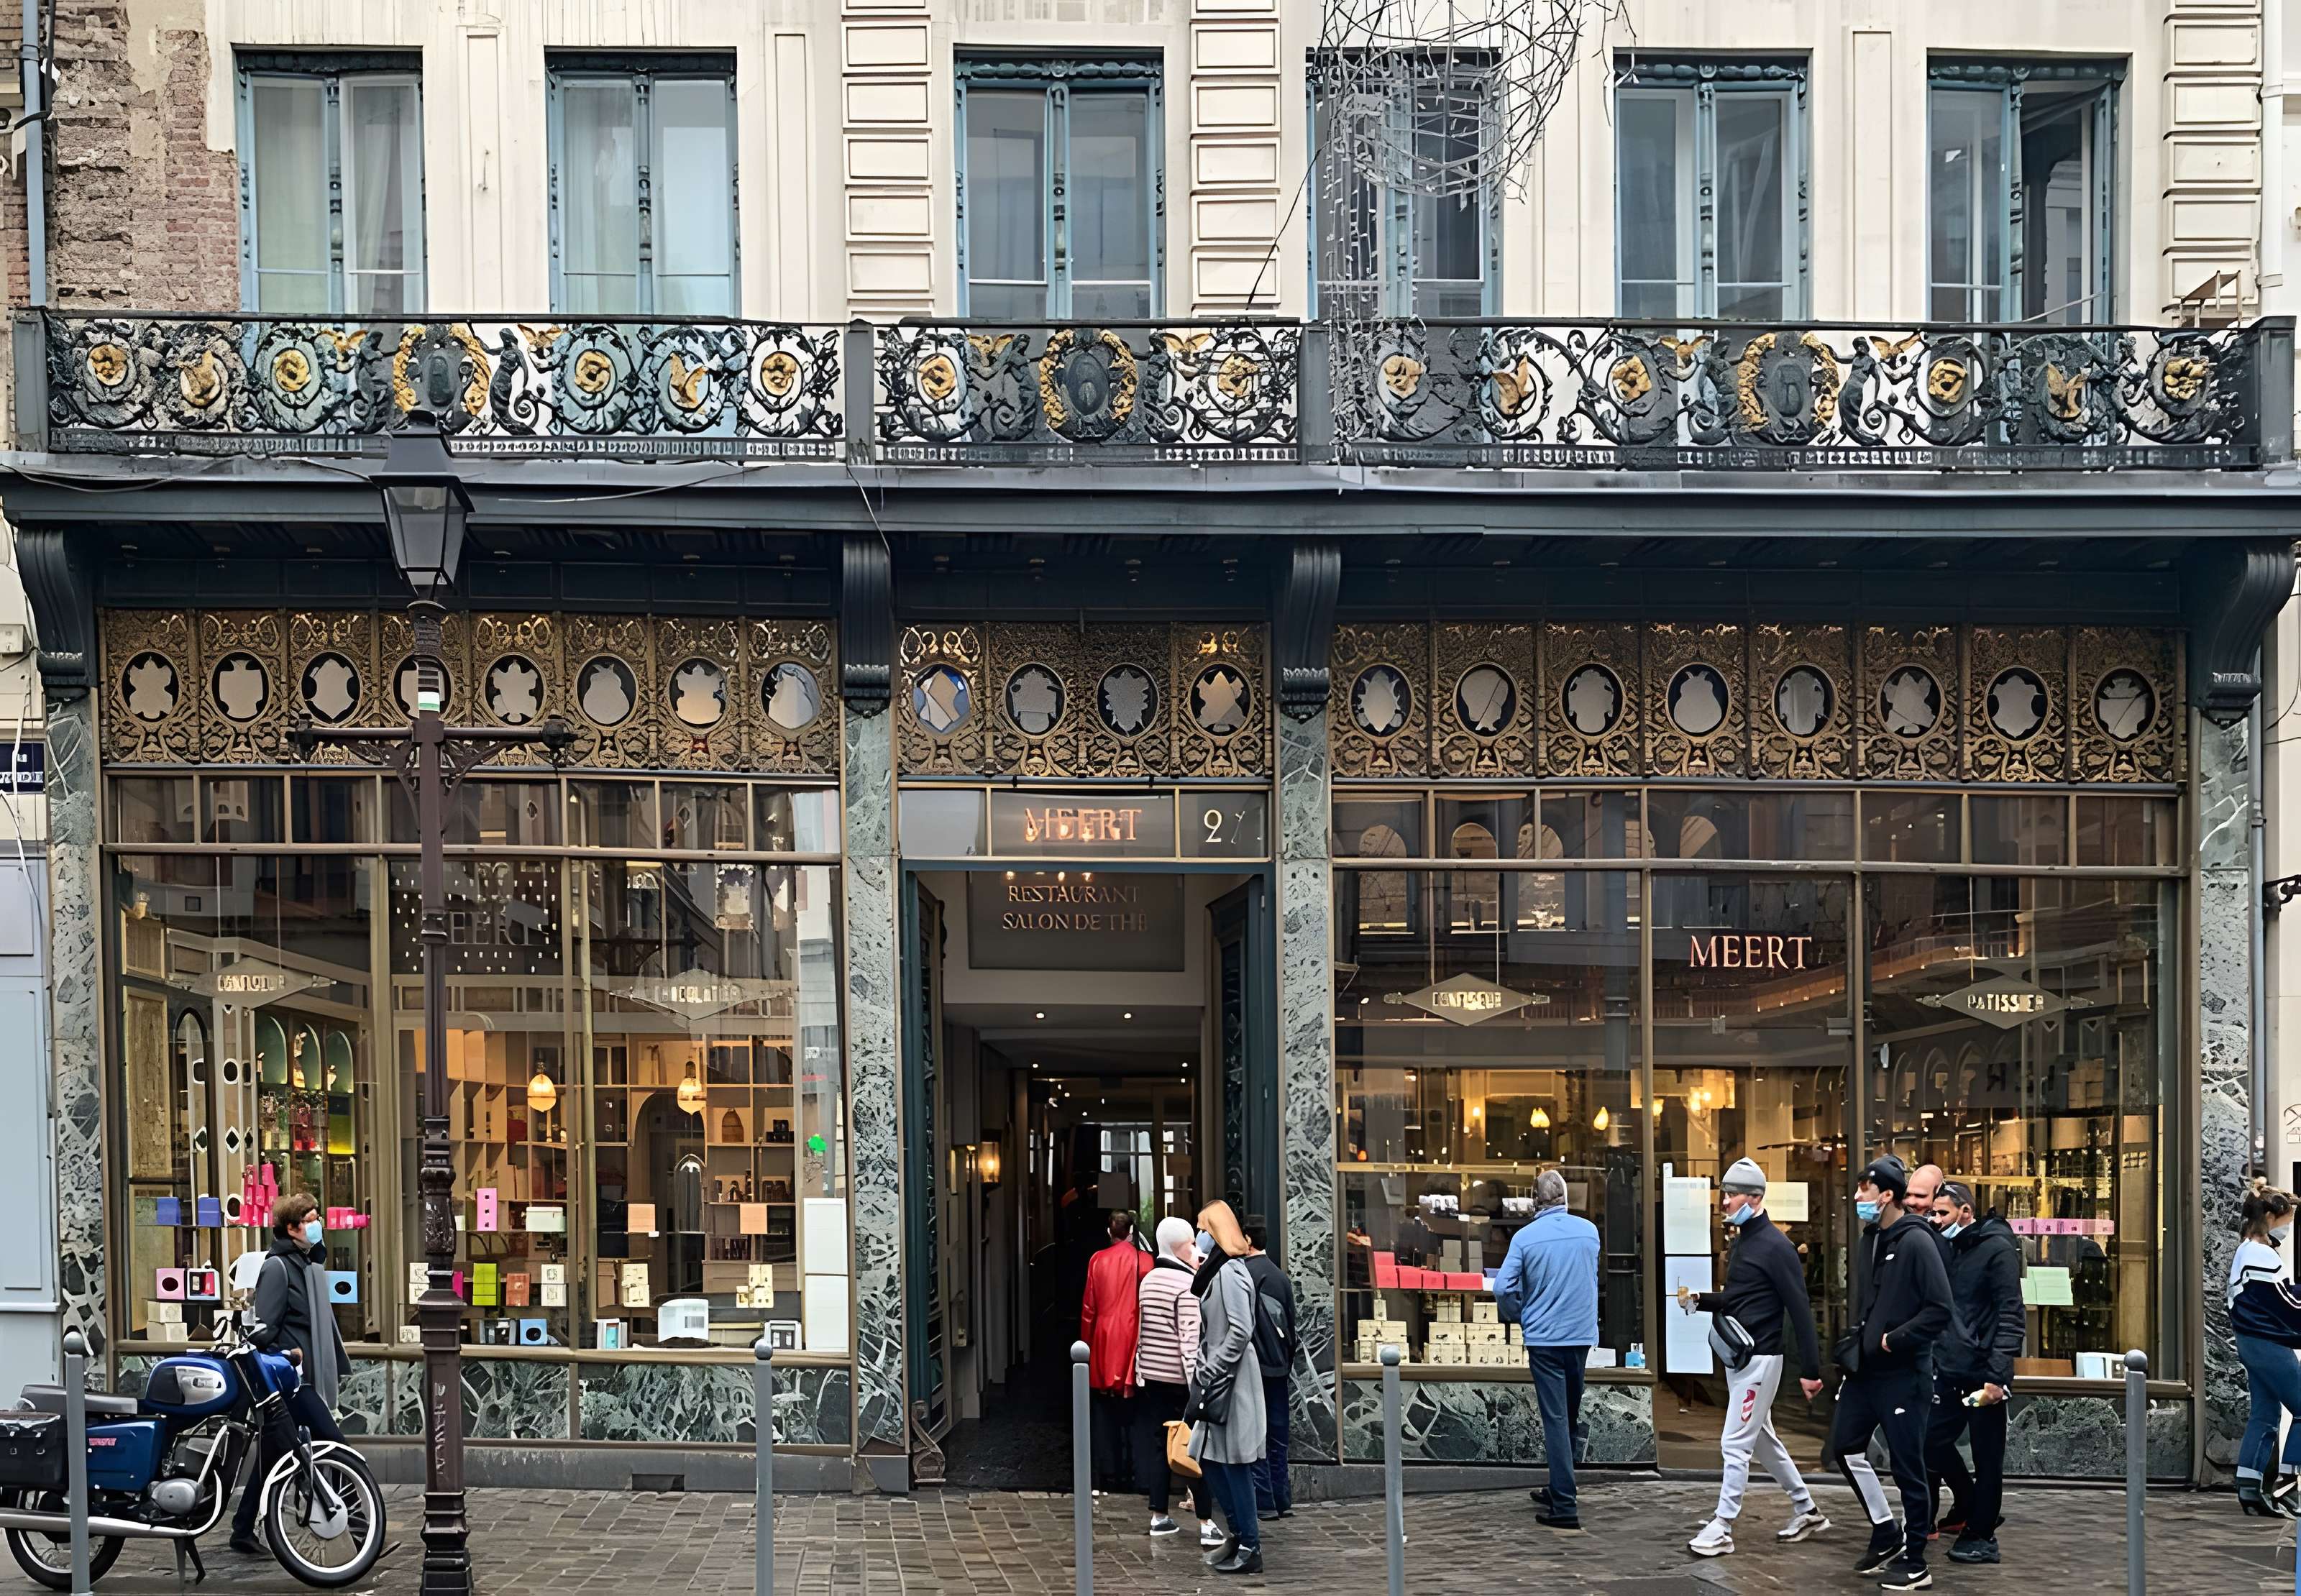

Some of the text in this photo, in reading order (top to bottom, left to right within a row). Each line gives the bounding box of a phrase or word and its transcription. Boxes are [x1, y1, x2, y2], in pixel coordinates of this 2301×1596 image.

[1008, 884, 1139, 903] RESTAURANT
[1002, 912, 1069, 930] SALON
[1075, 914, 1101, 930] DE
[1690, 934, 1812, 970] MEERT
